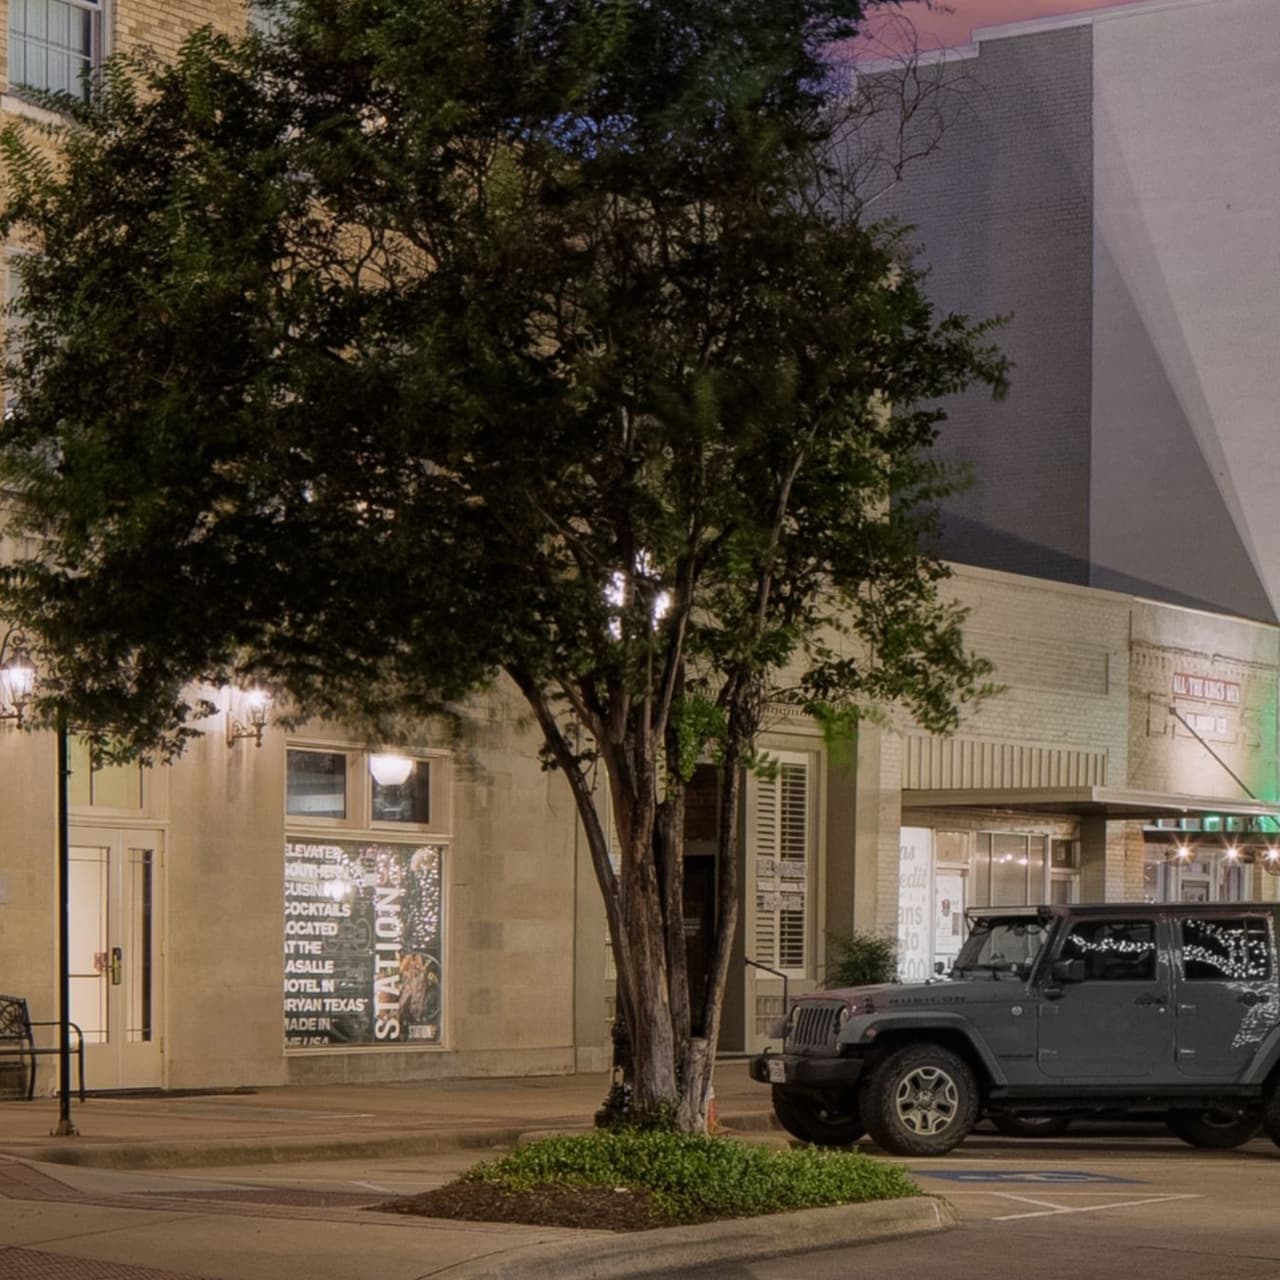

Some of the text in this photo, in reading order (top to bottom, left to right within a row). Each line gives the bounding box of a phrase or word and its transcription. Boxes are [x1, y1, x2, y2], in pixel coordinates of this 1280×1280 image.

[285, 920, 338, 936] OCATED
[298, 940, 322, 955] THE
[285, 959, 334, 974] ASALLE
[375, 887, 401, 1039] STATION
[284, 979, 334, 993] OTEL IN
